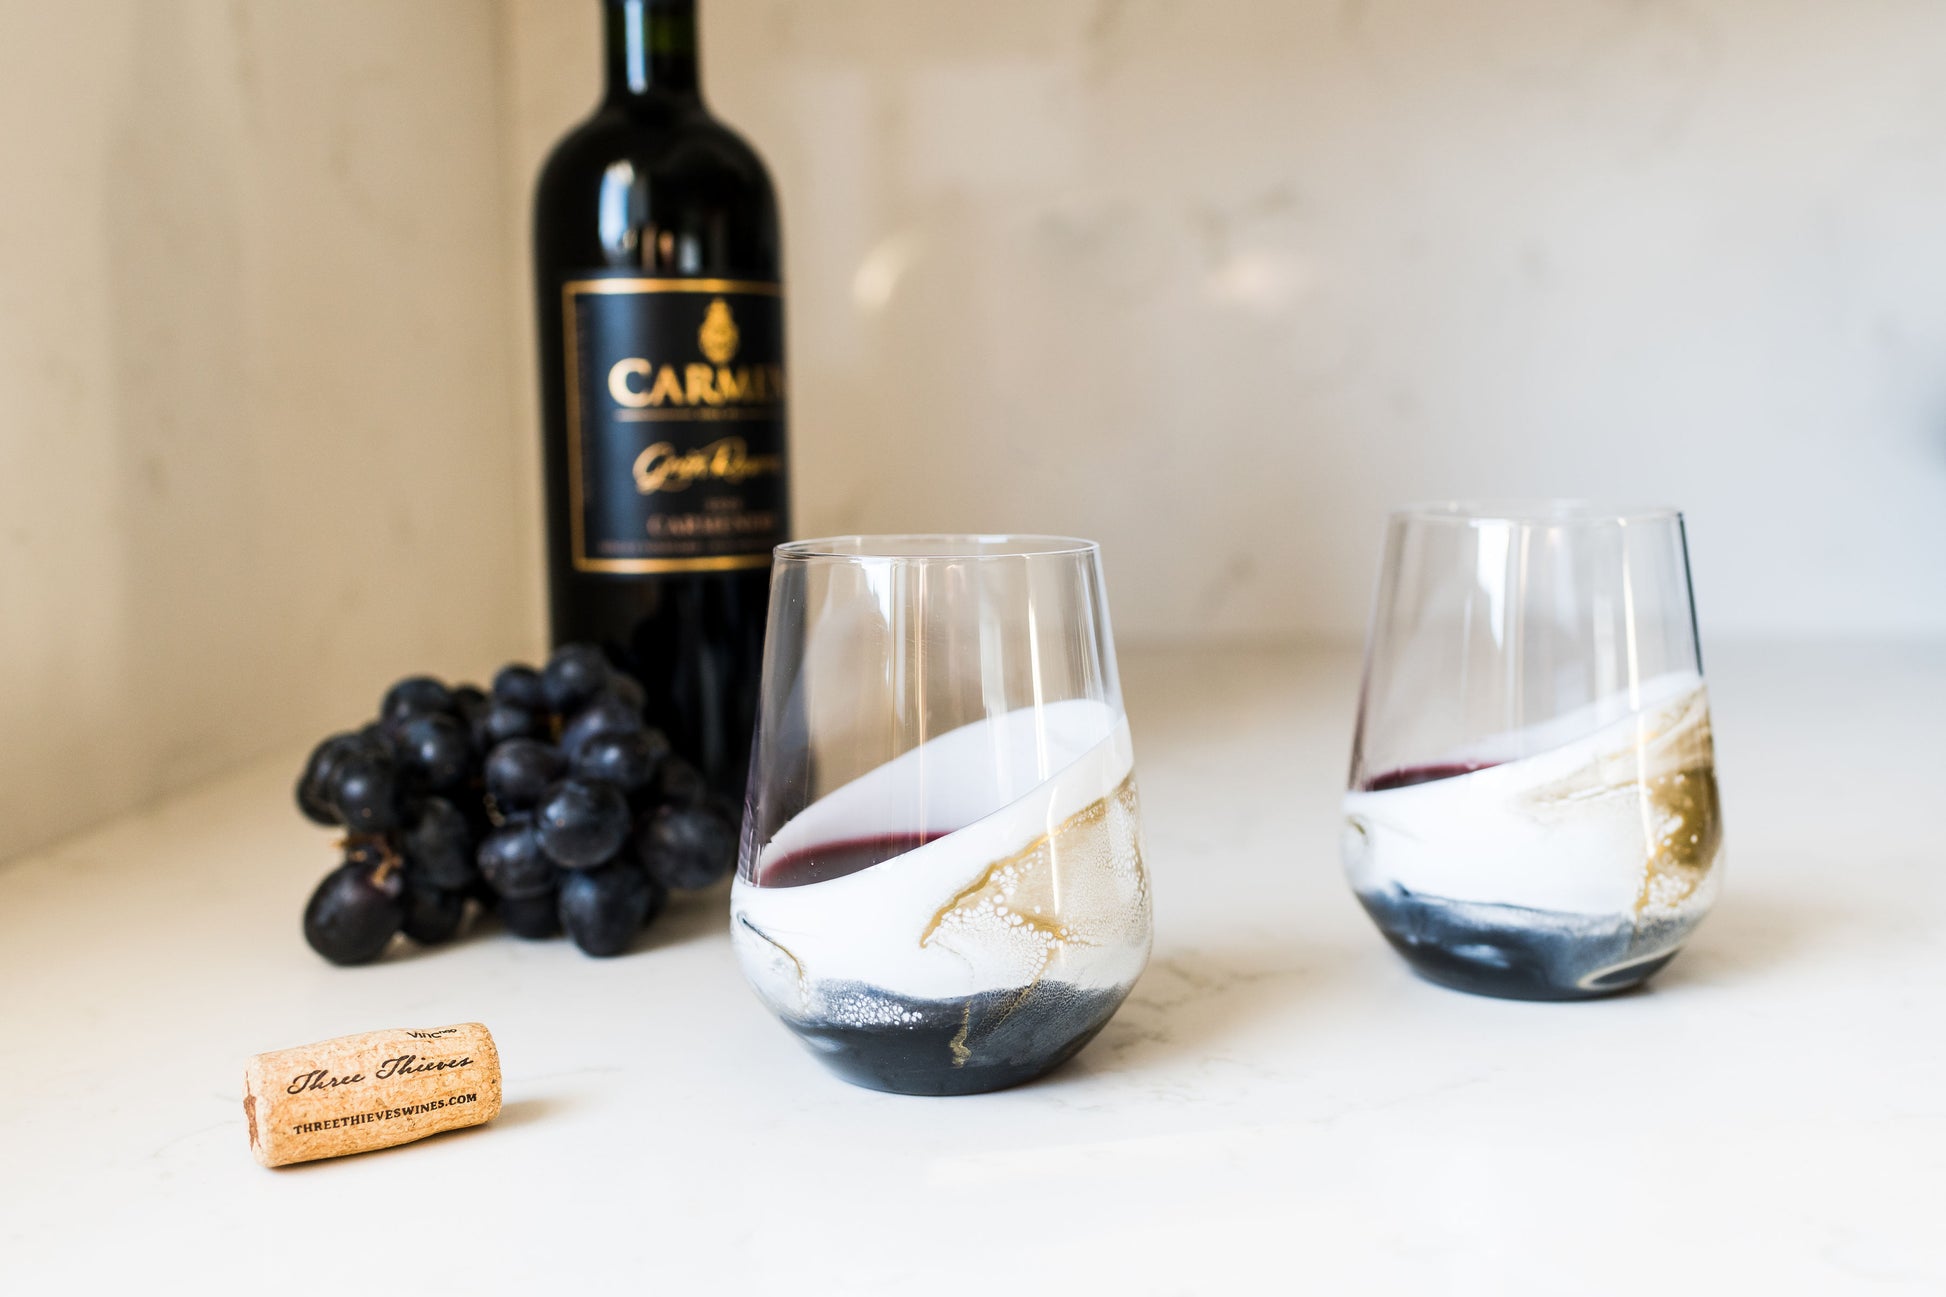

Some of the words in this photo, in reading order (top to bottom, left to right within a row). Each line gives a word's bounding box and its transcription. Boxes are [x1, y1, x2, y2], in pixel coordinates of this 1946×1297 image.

[286, 1069, 366, 1095] Three
[375, 1054, 474, 1080] Thieves
[293, 1093, 478, 1135] THREETHIEVESWINES.COM
